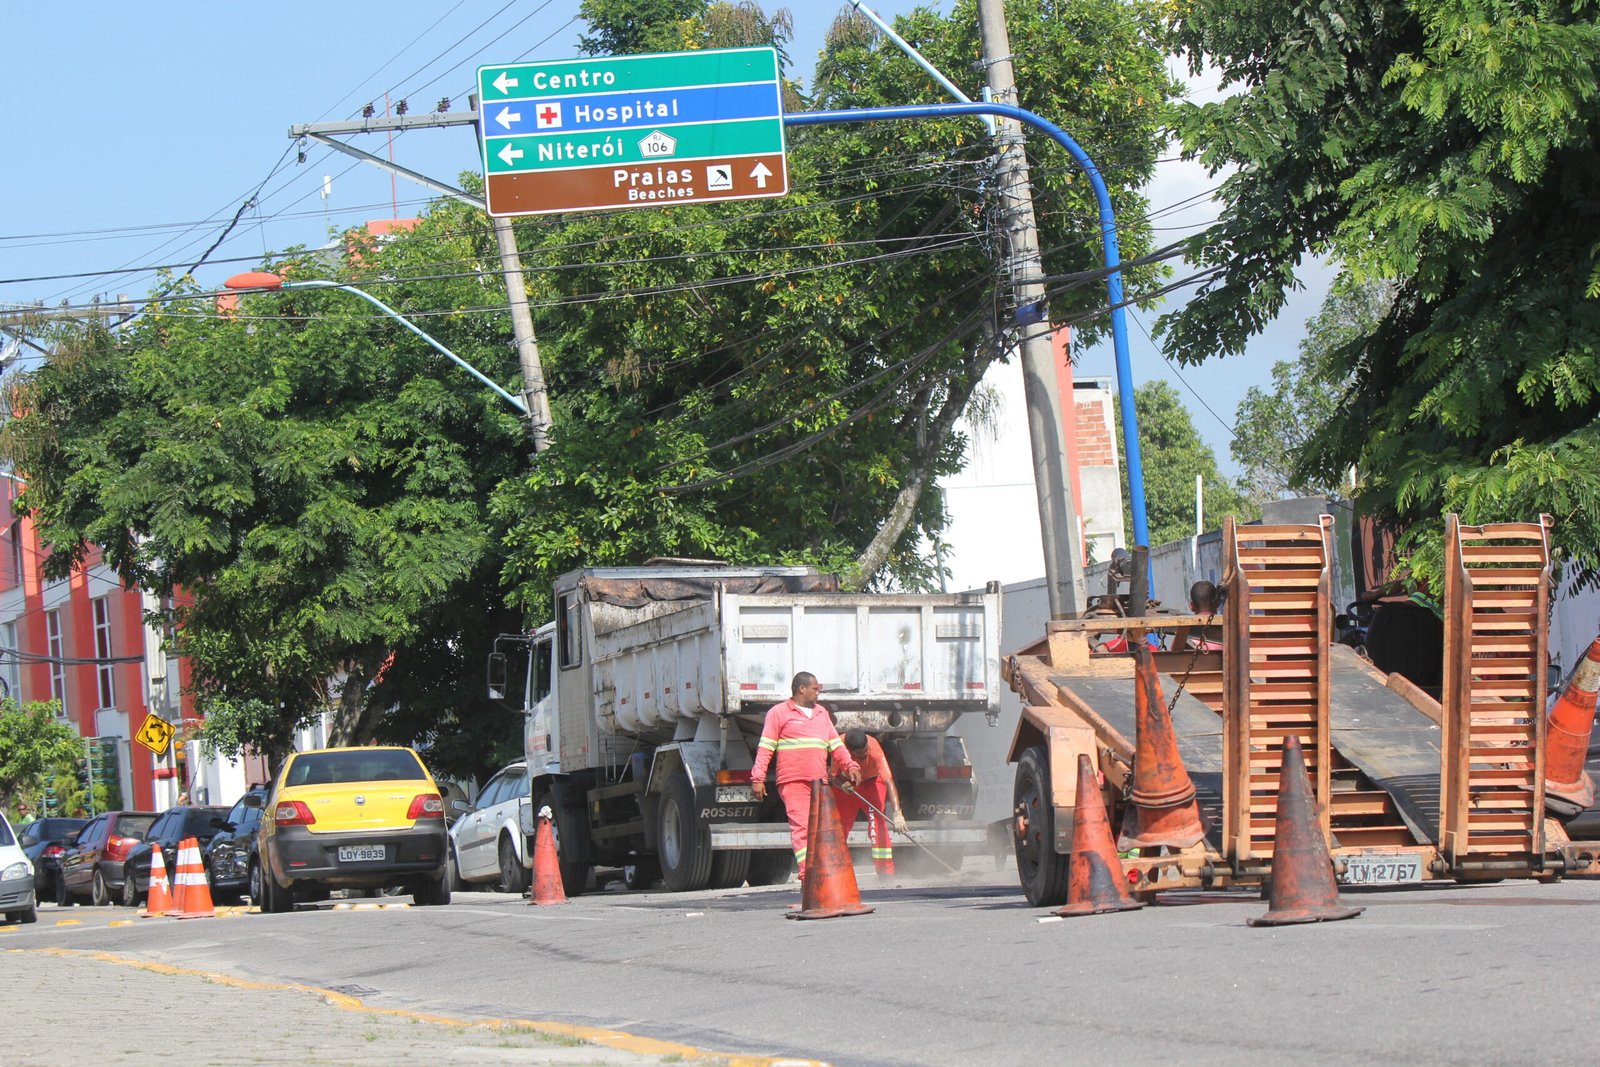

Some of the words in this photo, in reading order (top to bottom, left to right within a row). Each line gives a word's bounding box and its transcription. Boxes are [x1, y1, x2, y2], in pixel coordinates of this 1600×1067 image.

[533, 69, 615, 90] Centro
[575, 99, 678, 123] Hospital
[538, 136, 624, 161] Niterói
[648, 142, 667, 153] 106
[614, 167, 693, 188] Praias
[628, 186, 694, 201] Beaches
